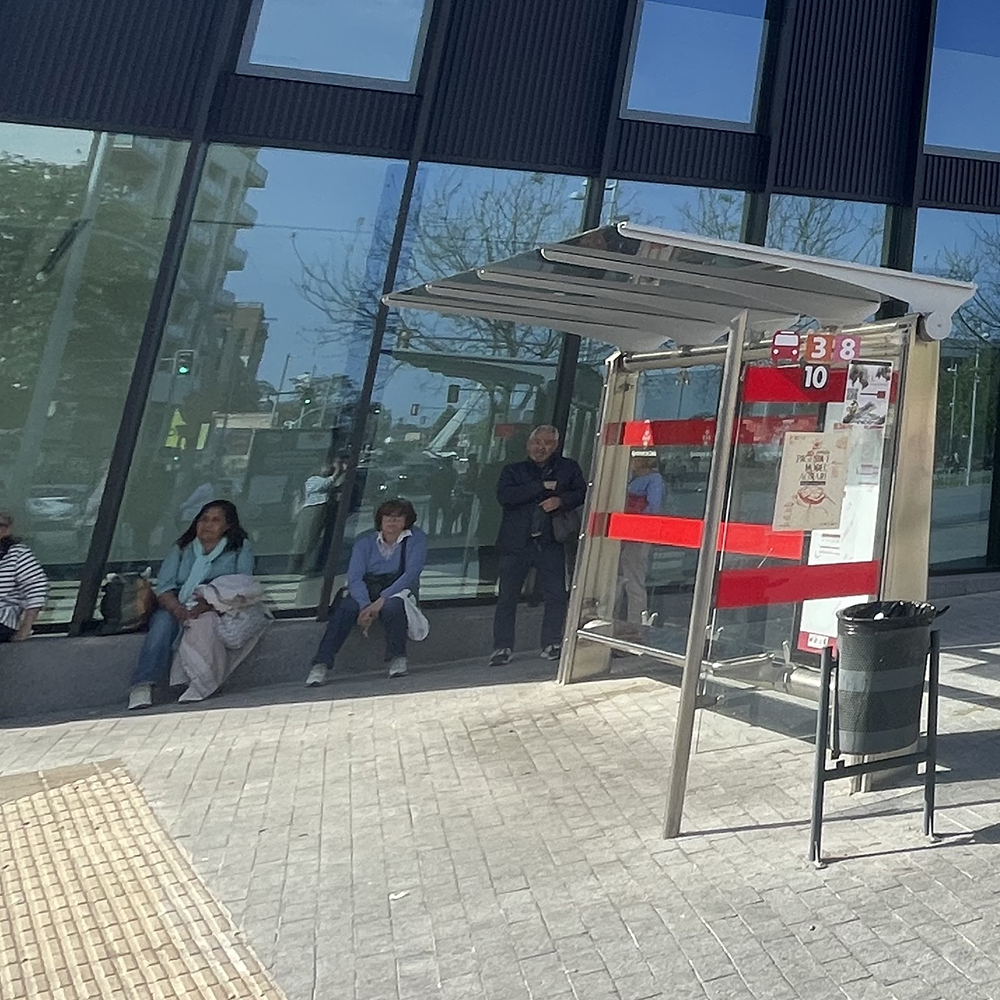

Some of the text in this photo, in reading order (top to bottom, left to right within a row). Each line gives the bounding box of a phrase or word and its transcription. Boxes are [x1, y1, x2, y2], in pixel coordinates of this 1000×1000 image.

[810, 336, 856, 361] 3 8
[804, 365, 828, 389] 10
